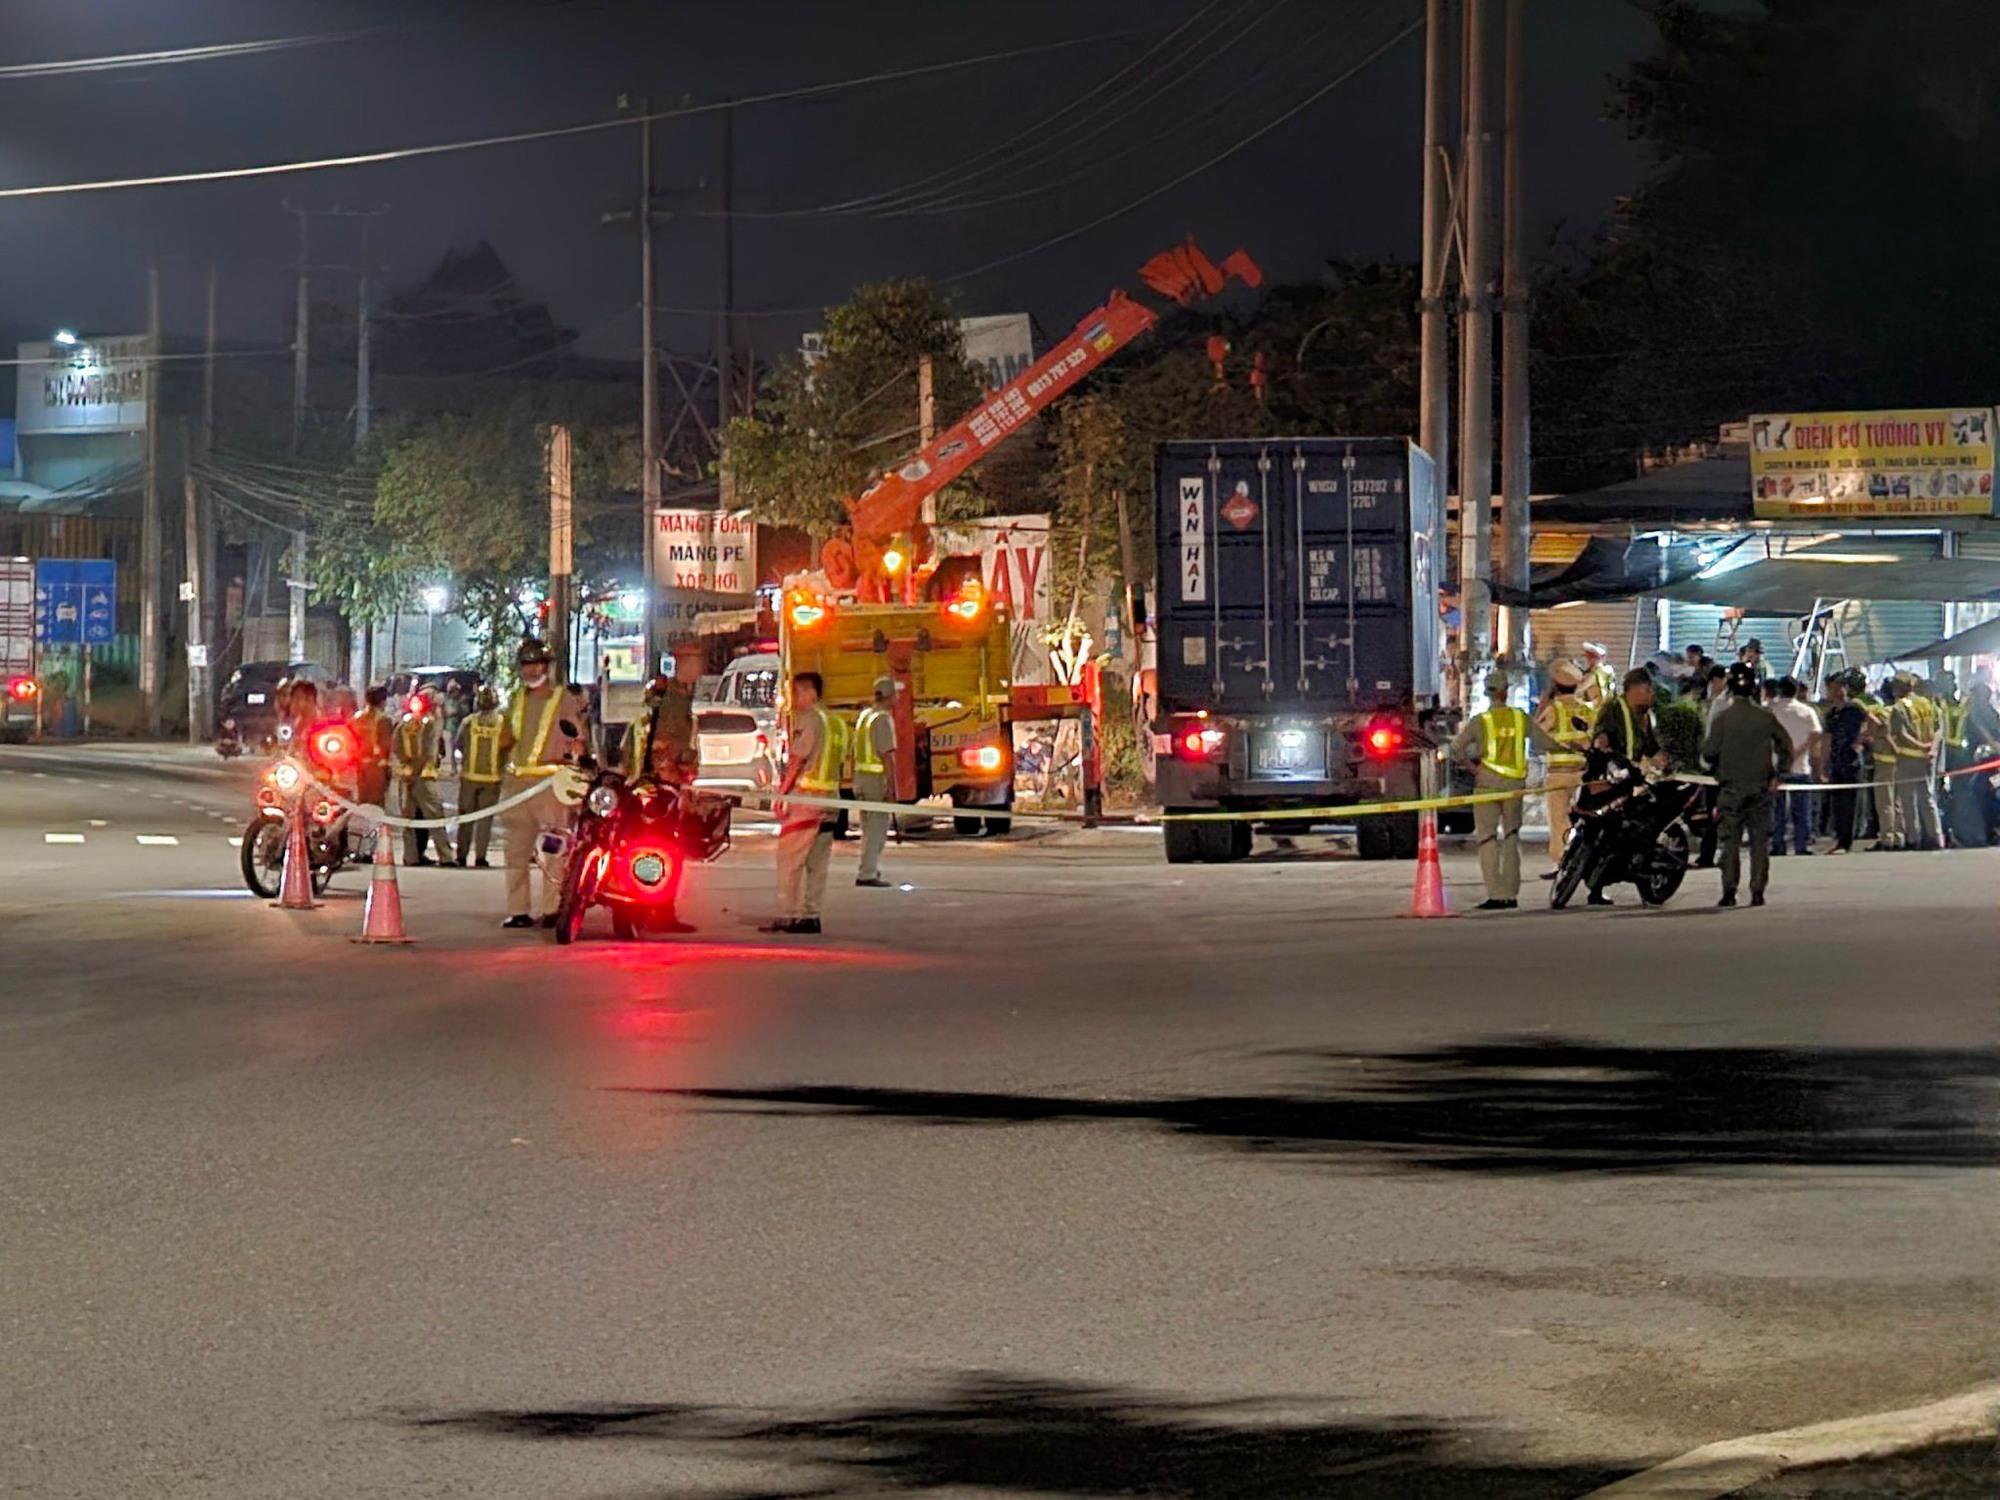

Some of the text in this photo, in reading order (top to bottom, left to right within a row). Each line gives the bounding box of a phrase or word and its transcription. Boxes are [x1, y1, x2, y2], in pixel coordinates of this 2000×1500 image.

[1925, 421, 1946, 447] VY
[1182, 486, 1201, 592] WAN HAI
[723, 546, 745, 561] PE
